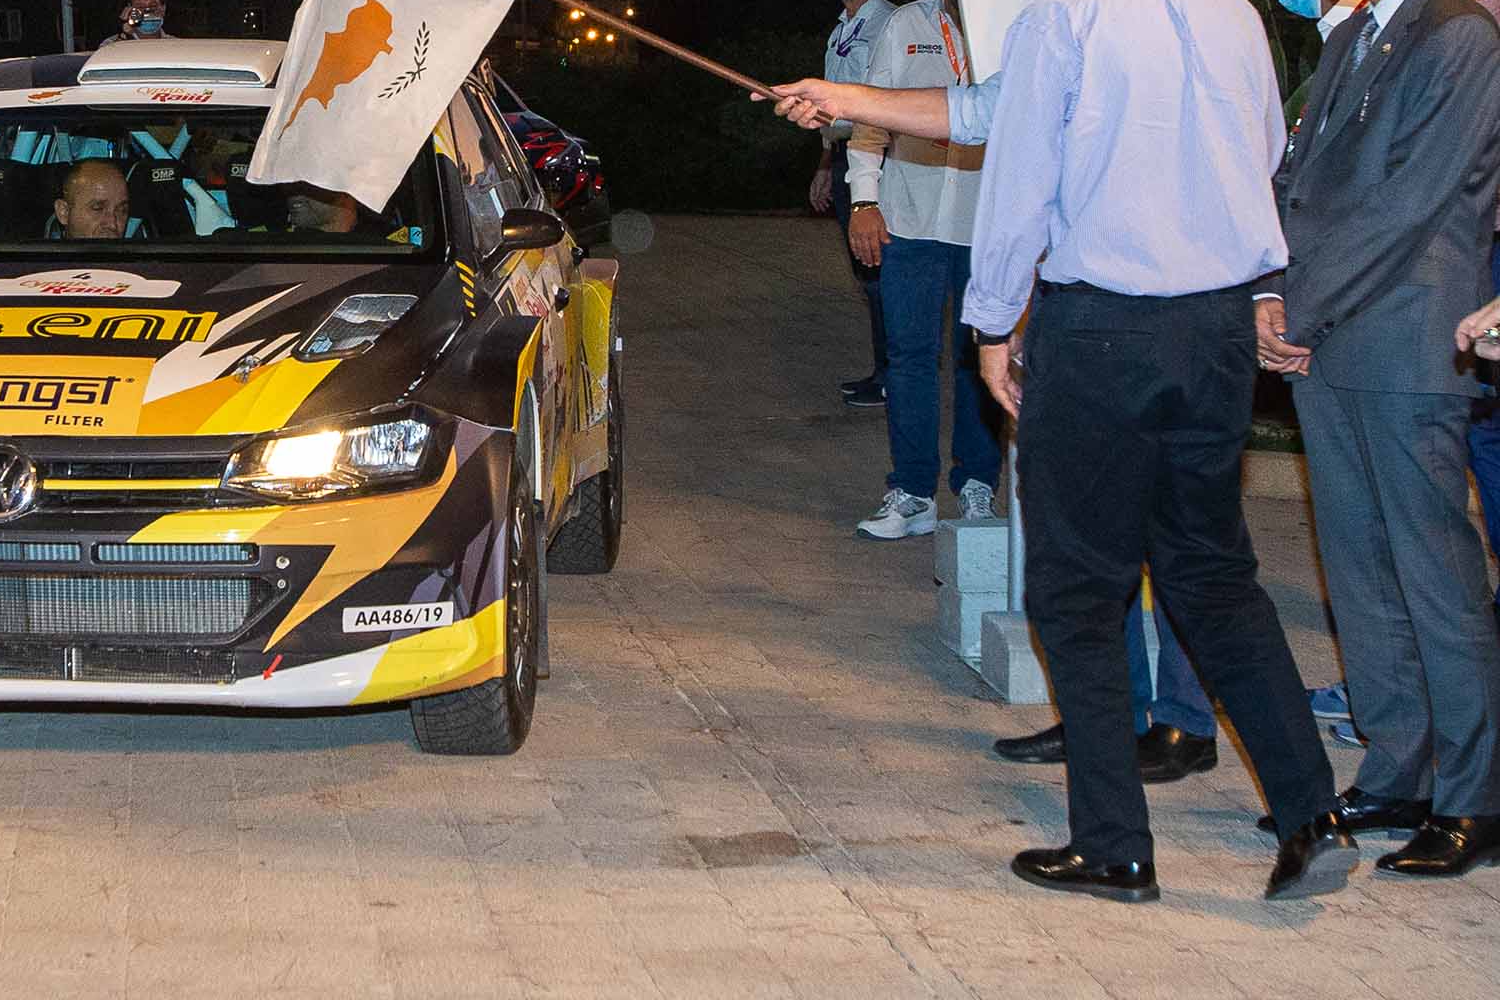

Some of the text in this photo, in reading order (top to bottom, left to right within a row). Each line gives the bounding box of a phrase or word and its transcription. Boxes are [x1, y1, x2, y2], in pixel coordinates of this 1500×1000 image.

[152, 169, 175, 179] OMP
[231, 166, 248, 175] OM
[72, 272, 91, 280] 4
[27, 310, 206, 342] eni
[44, 414, 104, 428] FILTER
[355, 606, 443, 627] AA486/19
